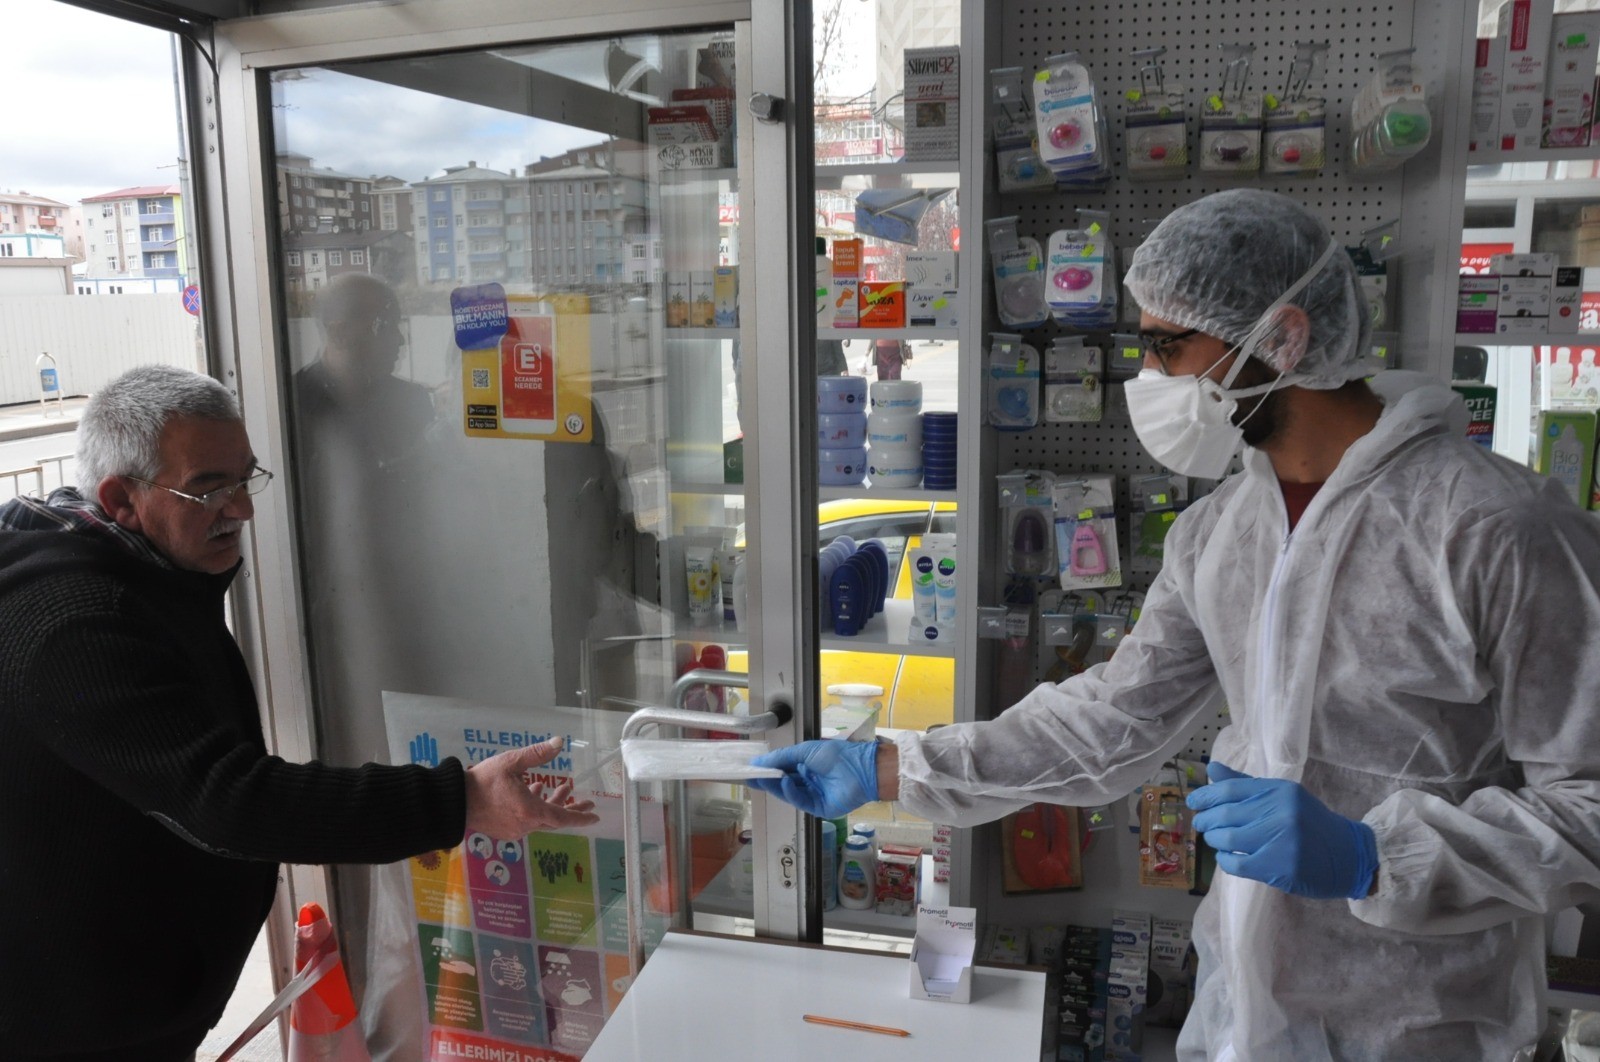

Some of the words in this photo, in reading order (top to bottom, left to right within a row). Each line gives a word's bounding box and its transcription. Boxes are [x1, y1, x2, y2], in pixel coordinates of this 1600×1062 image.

[455, 309, 506, 324] BULMANIN
[466, 321, 488, 329] KOLAY
[488, 319, 507, 327] YOLU
[514, 382, 543, 390] NEREDE
[474, 421, 485, 429] App
[438, 1040, 520, 1062] ELLERİMİZİ
